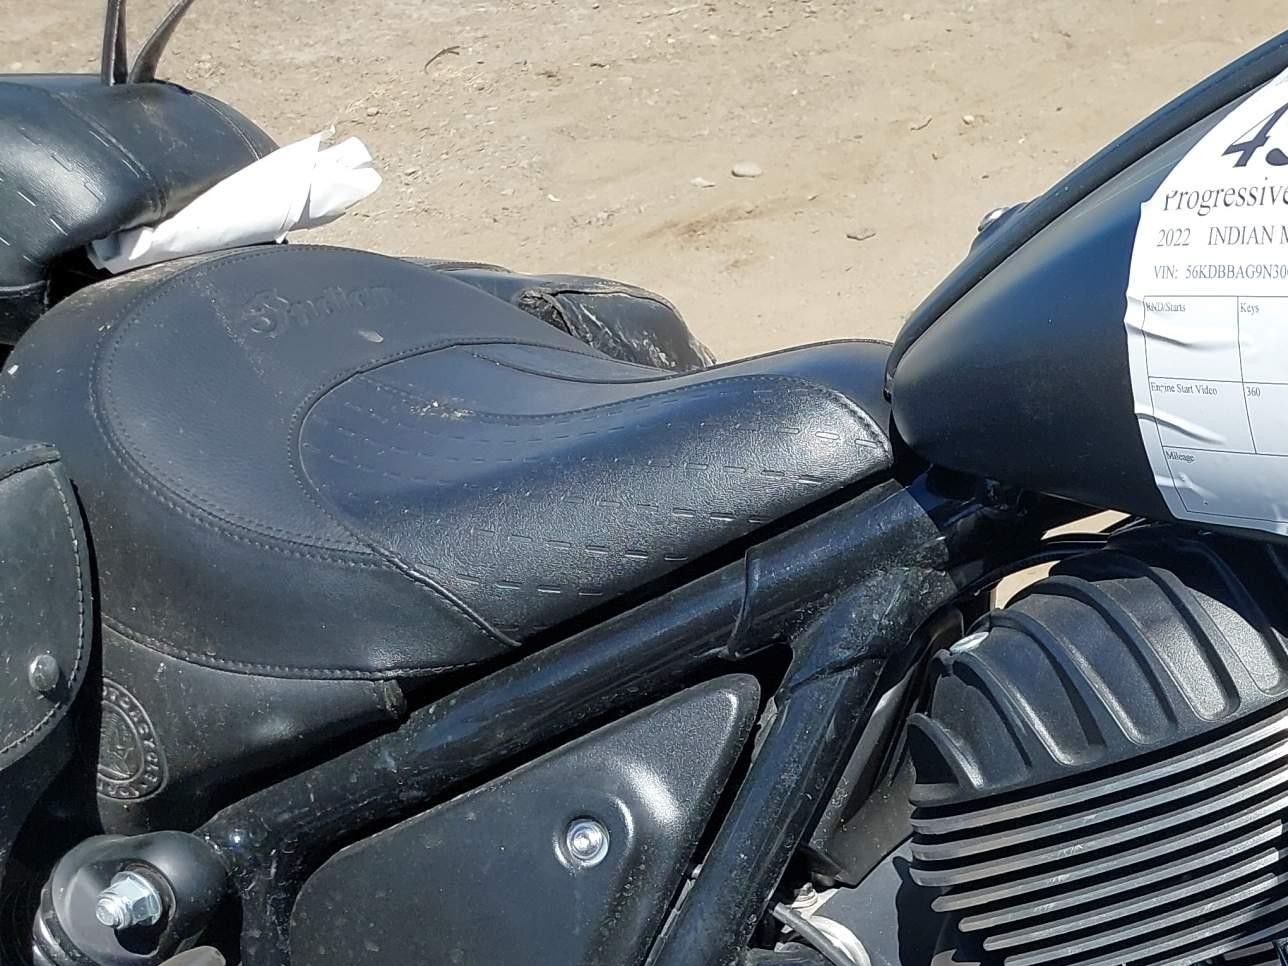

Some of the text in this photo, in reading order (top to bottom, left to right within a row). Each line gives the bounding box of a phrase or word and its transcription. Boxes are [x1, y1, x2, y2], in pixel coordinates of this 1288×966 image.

[1156, 228, 1191, 247] 2022
[1208, 225, 1274, 246] INDIAN
[1154, 265, 1179, 280] VIN:
[1240, 302, 1260, 316] Keys
[1176, 383, 1194, 394] Start
[1195, 384, 1218, 395] Video
[1246, 386, 1261, 397] 360
[1166, 450, 1195, 463] Mileage
